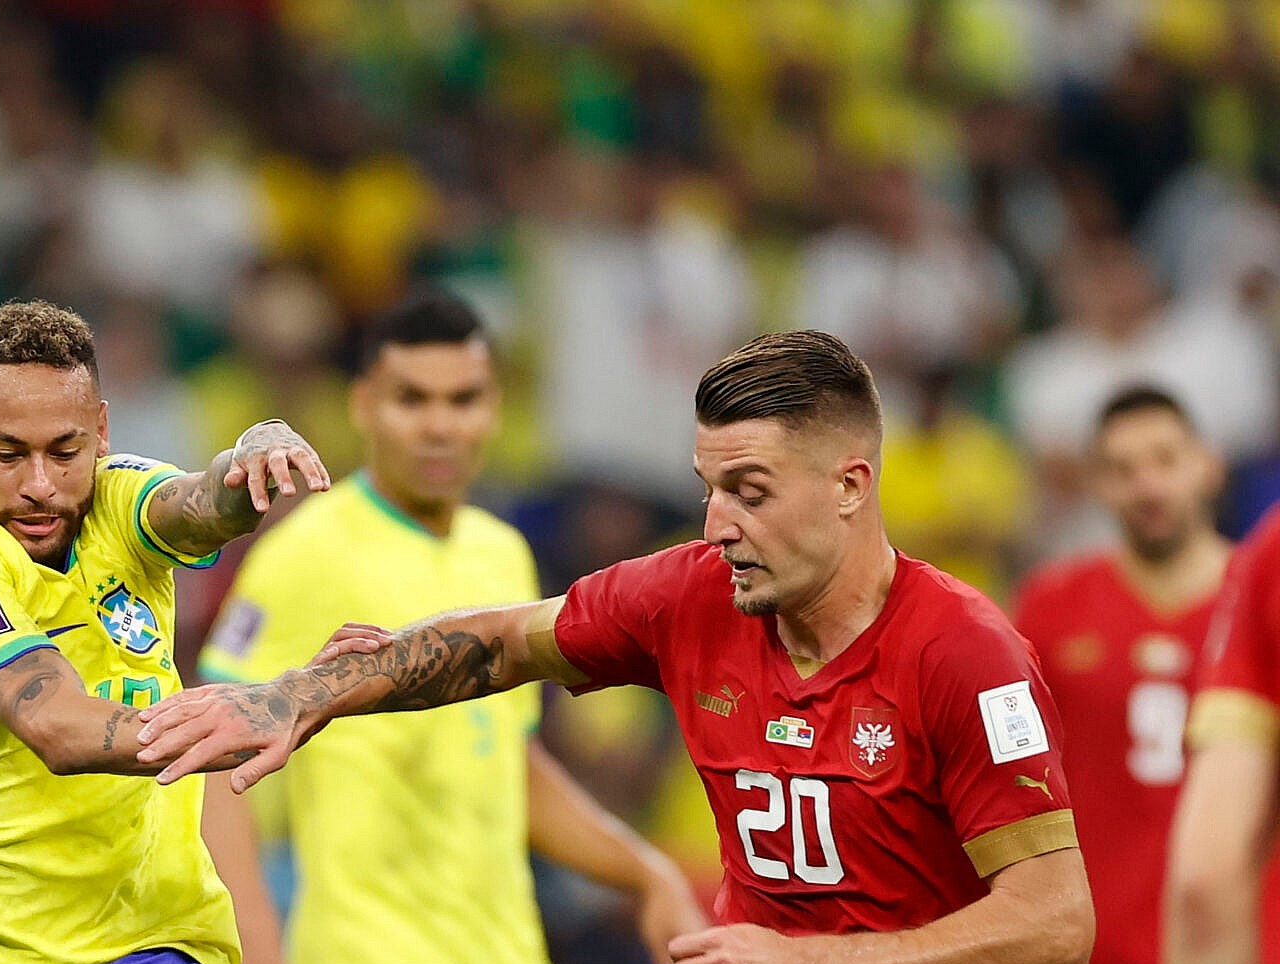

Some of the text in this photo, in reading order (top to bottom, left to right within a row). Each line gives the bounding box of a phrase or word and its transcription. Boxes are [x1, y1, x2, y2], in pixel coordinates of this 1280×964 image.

[121, 608, 134, 632] CBF
[1127, 681, 1189, 785] 9
[734, 768, 845, 885] 20
